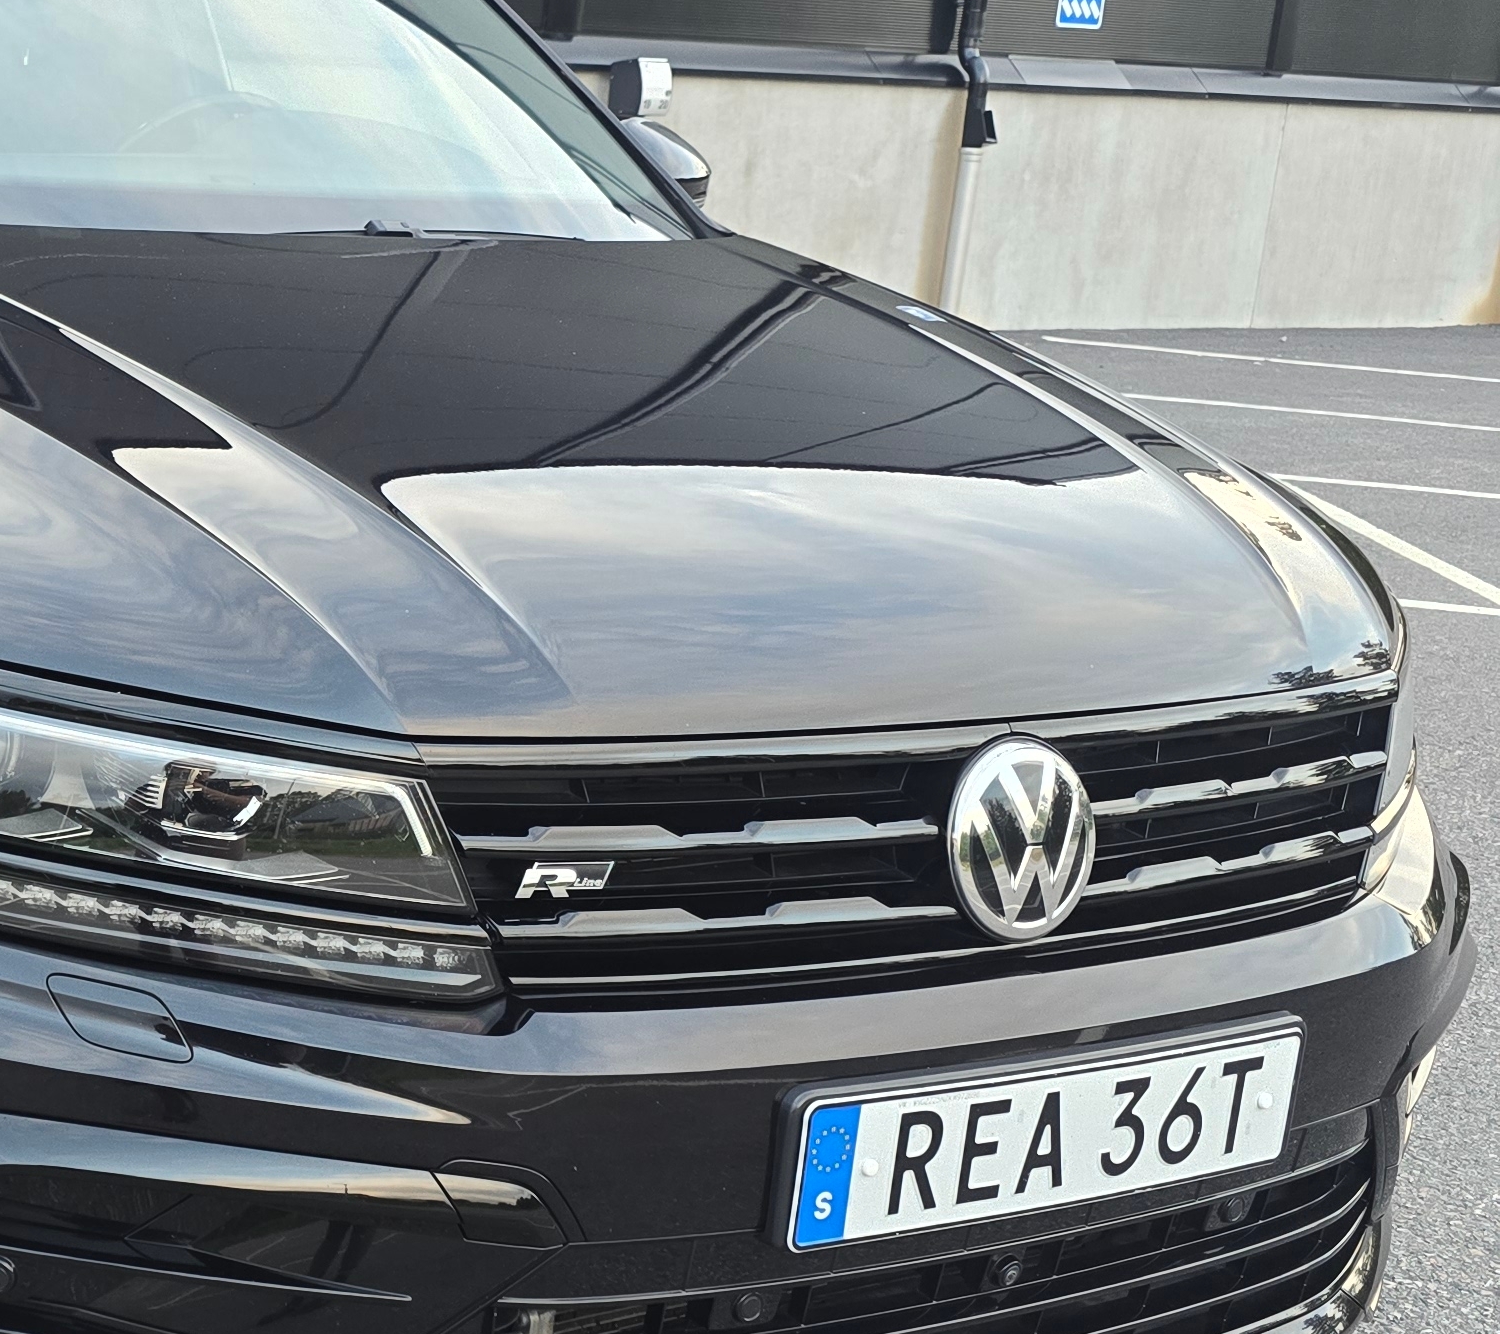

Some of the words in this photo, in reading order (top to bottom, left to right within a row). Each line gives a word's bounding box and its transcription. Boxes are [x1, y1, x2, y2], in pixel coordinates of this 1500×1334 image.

[515, 869, 577, 898] R
[887, 1092, 1063, 1216] REA
[1100, 1056, 1265, 1177] 36T
[813, 1191, 833, 1220] S
